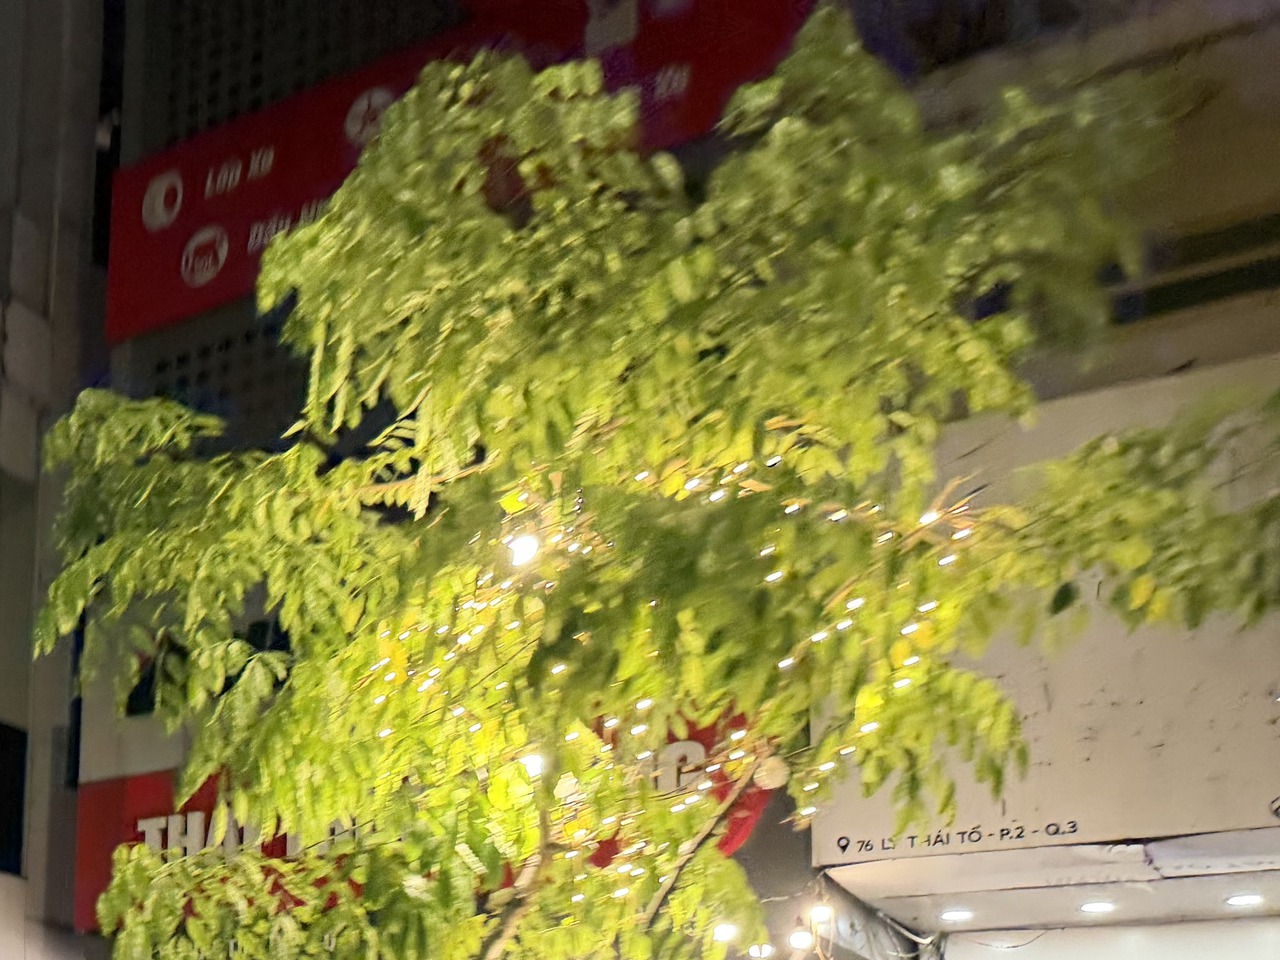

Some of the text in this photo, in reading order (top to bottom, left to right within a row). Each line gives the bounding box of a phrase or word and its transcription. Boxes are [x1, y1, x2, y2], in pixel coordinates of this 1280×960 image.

[856, 840, 874, 853] 76
[1000, 825, 1025, 841] P.2
[1045, 820, 1078, 836] Q.3
